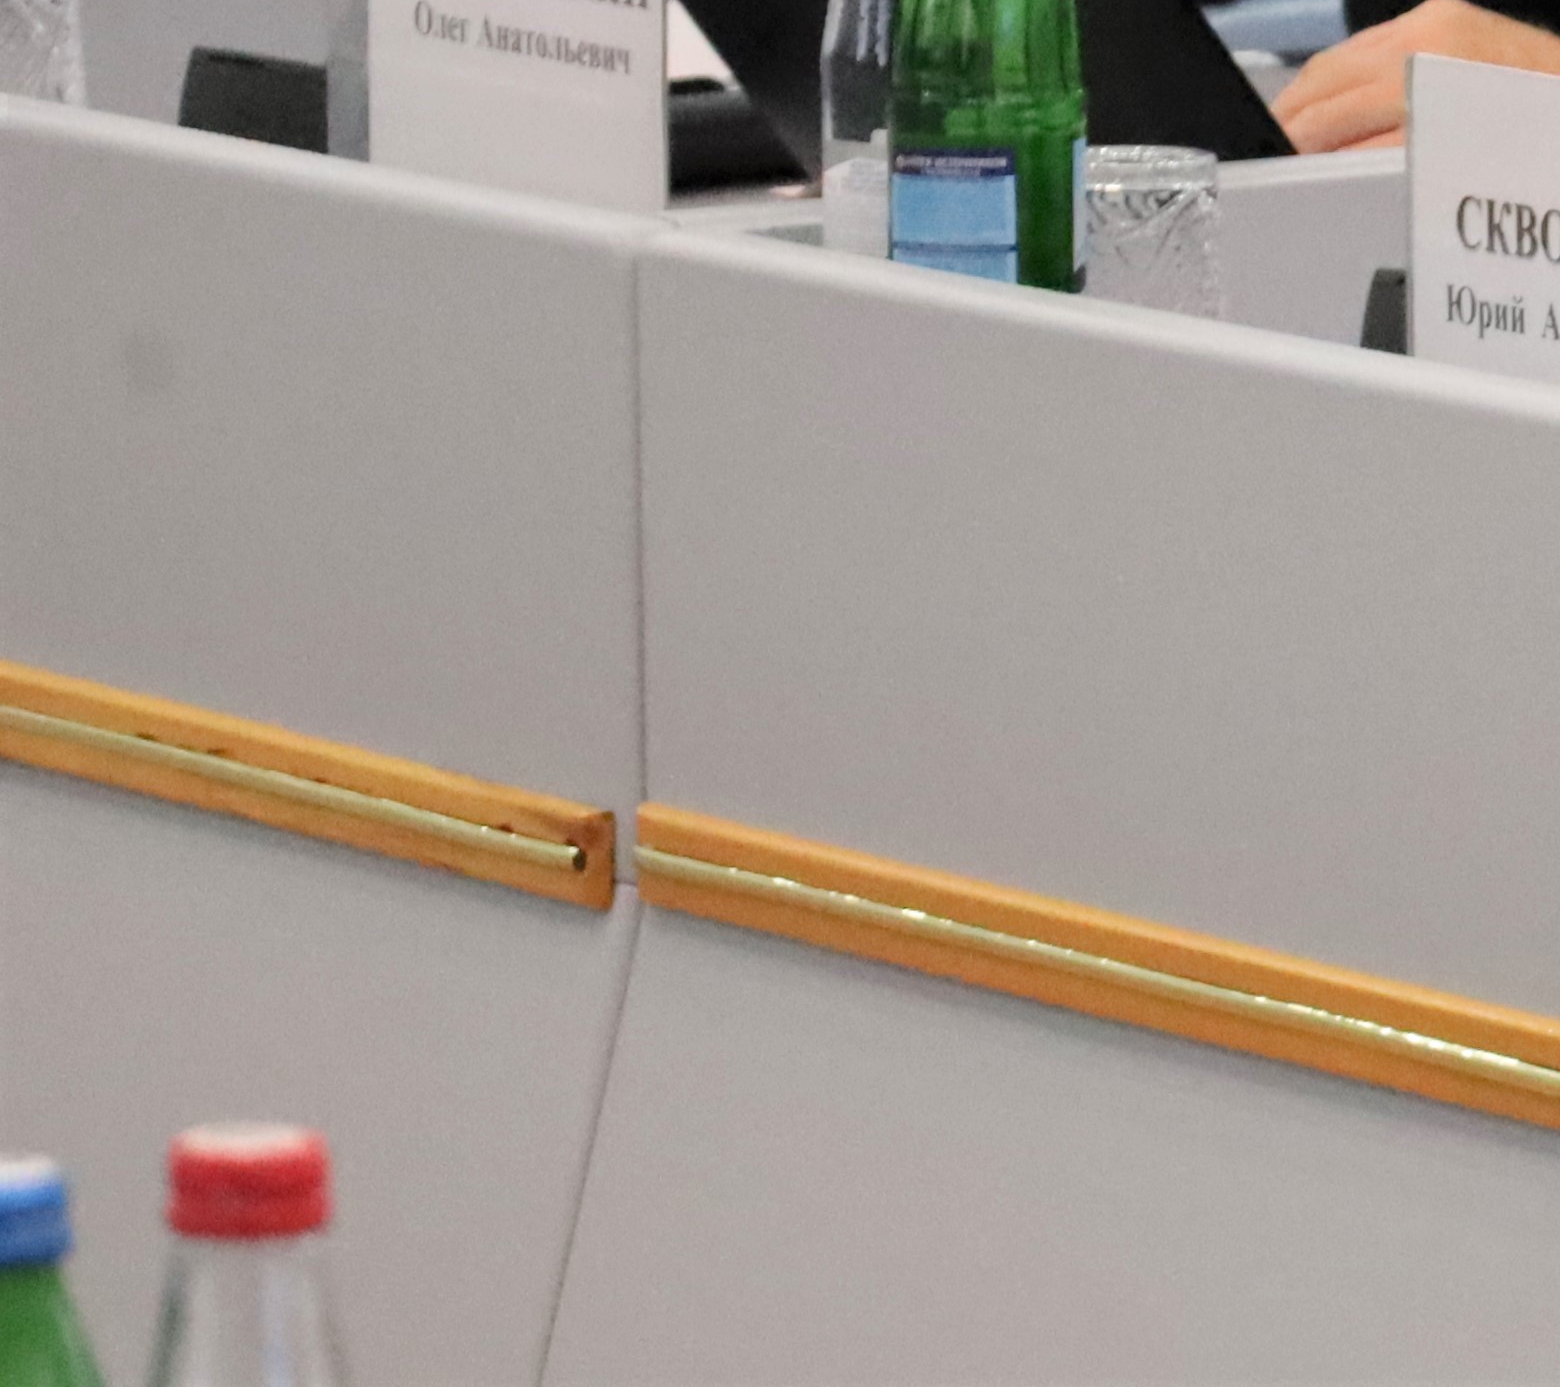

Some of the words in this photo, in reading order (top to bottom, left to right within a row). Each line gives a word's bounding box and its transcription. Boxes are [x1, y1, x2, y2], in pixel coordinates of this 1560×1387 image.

[414, 0, 467, 42] Олег
[477, 17, 632, 75] Анатольевич
[1446, 283, 1526, 339] Юрий
